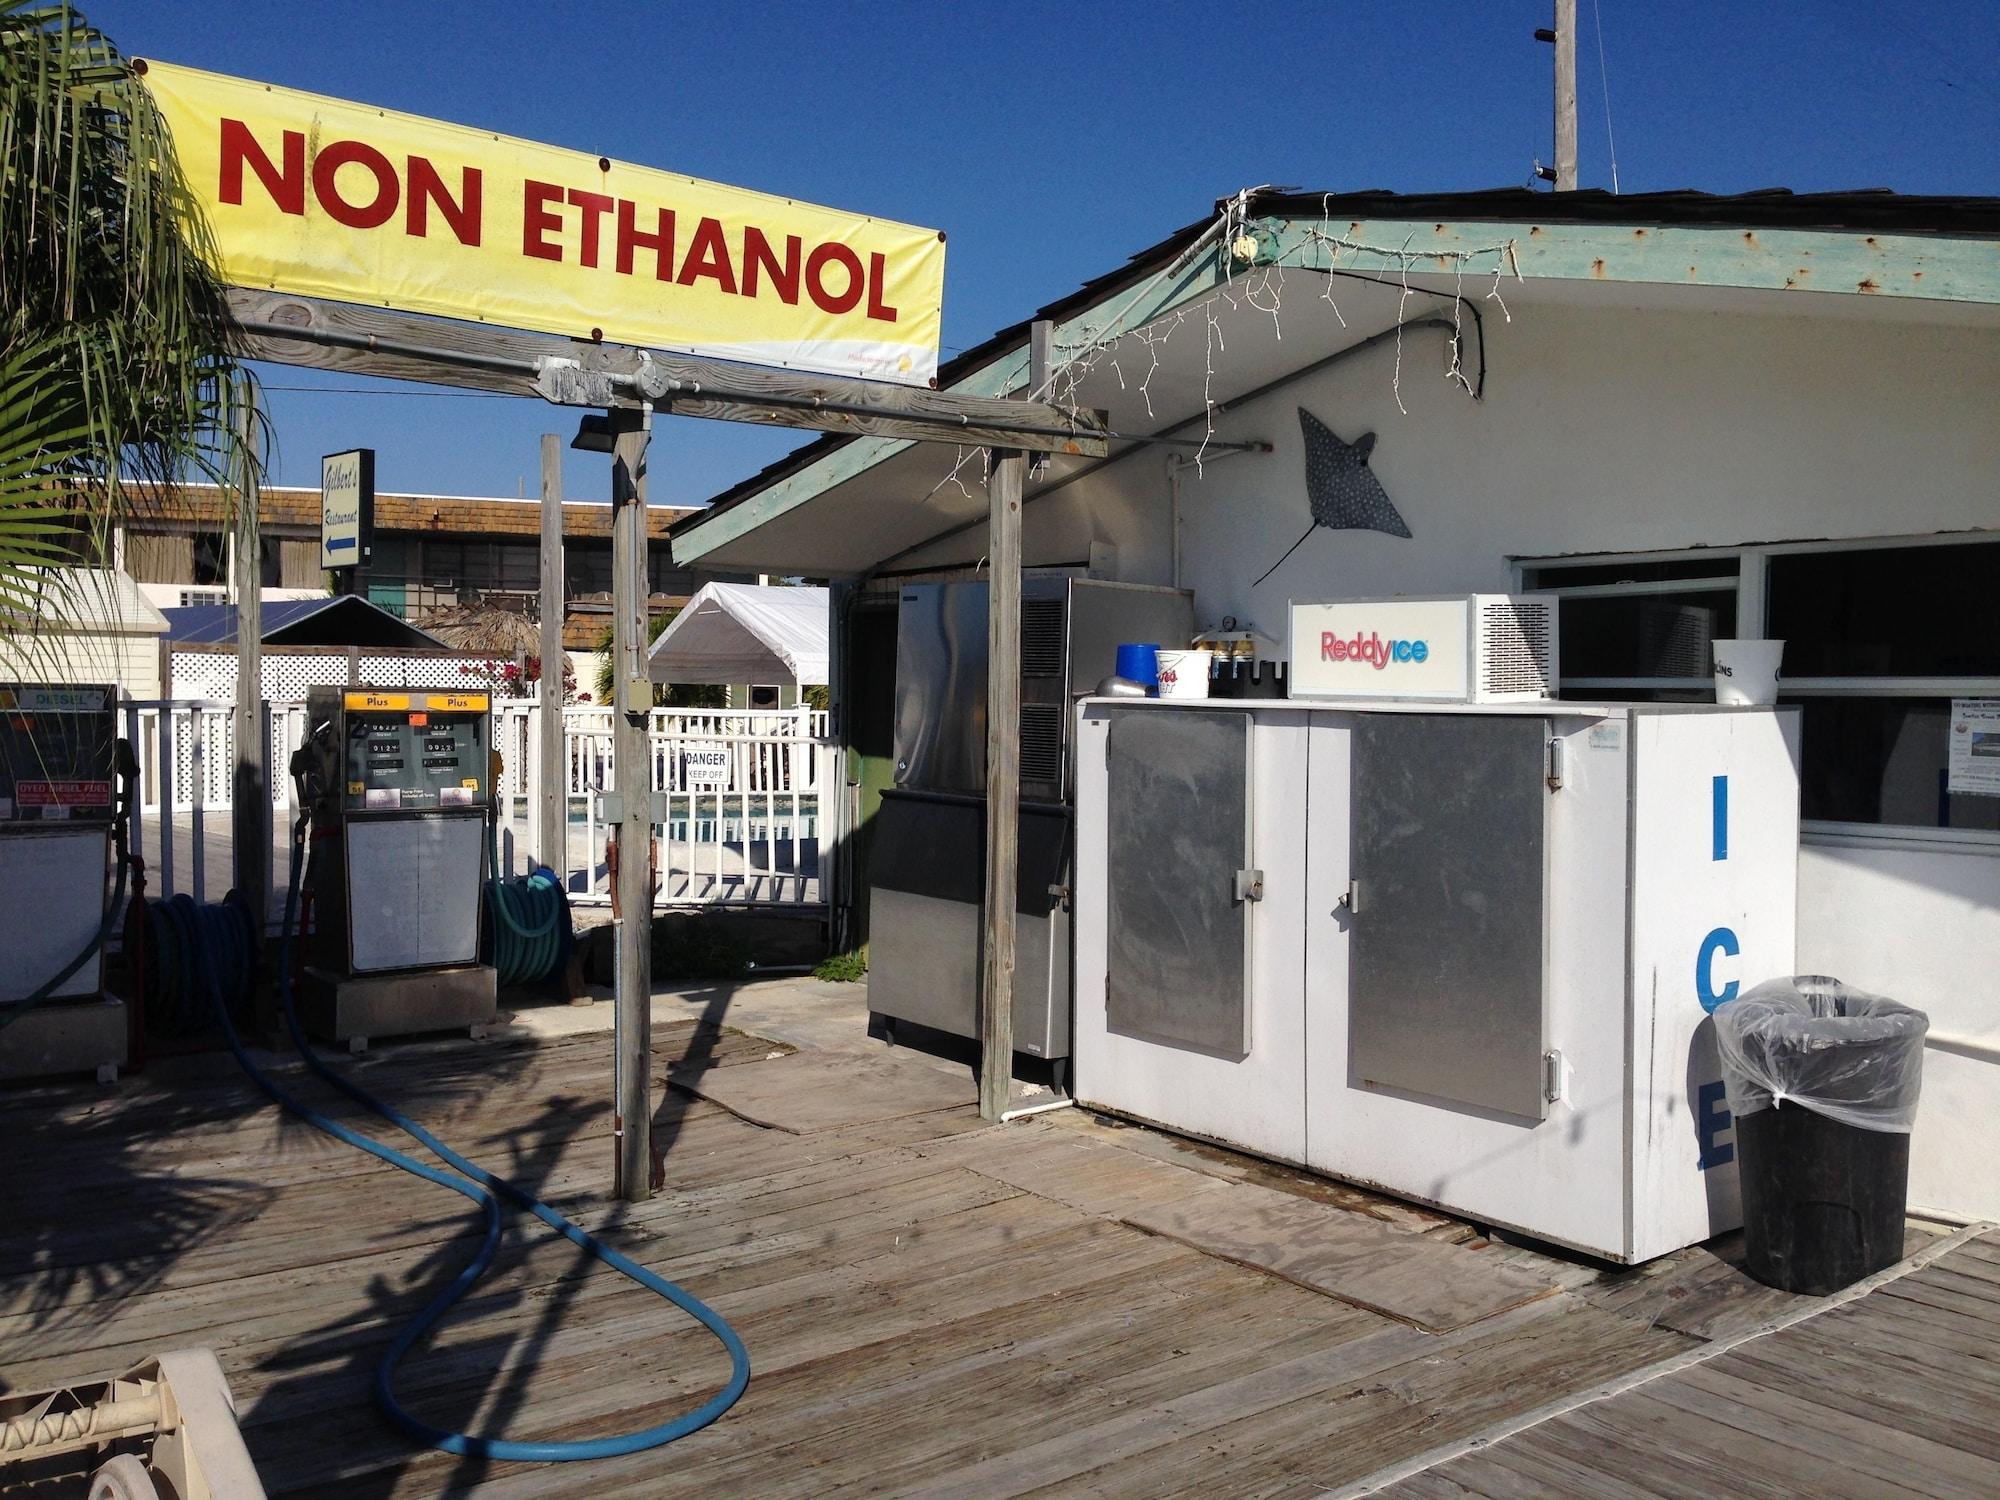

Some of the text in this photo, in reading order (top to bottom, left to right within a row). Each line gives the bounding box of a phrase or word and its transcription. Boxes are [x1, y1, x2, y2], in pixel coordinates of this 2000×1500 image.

[218, 117, 898, 323] NON ETHANOL
[325, 461, 357, 502] Gilbert's
[325, 509, 358, 527] Restaurant
[36, 694, 86, 705] DIESEL
[367, 697, 389, 707] Plus
[447, 698, 468, 708] Plus
[686, 752, 725, 765] DANGER
[689, 770, 723, 778] KEEP OFF
[20, 784, 108, 793] DYED DIESEL FUEL
